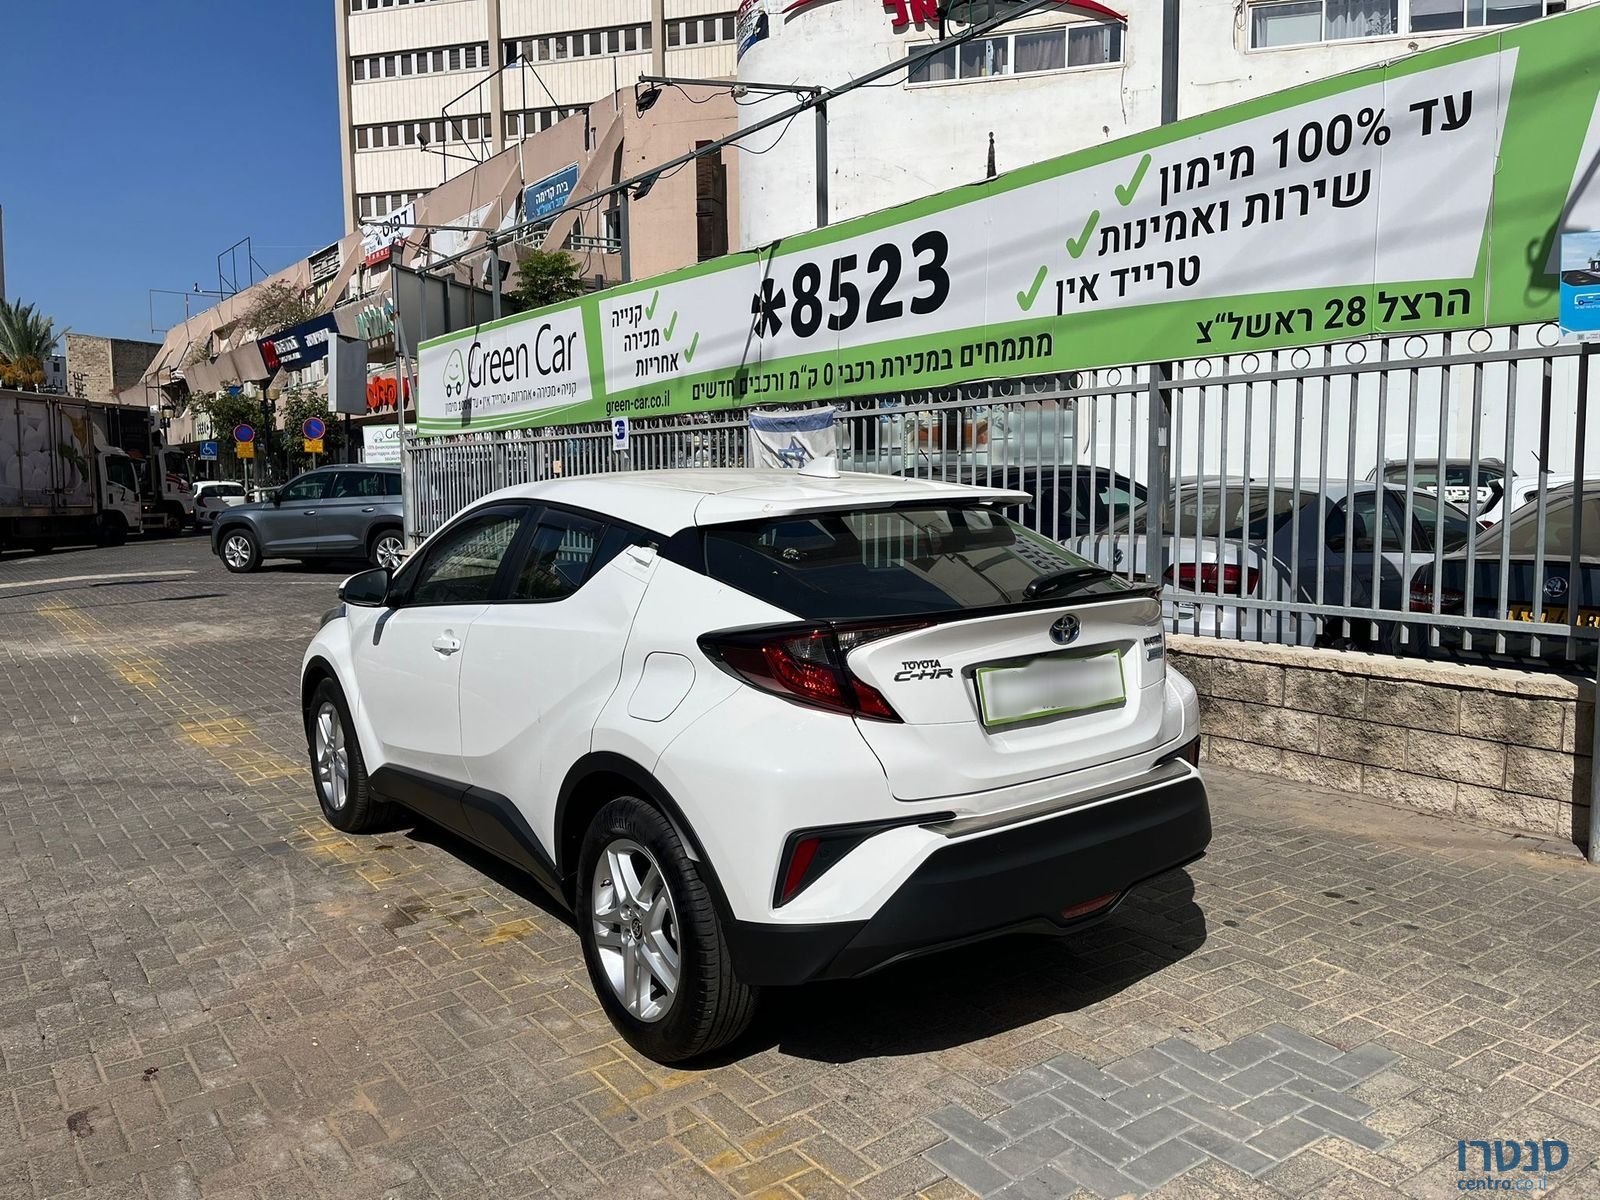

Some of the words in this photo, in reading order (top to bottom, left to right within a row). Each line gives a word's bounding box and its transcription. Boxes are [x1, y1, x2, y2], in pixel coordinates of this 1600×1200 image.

[1409, 90, 1473, 136] עד
[1272, 107, 1391, 169] 100%
[1159, 145, 1255, 207] מימון
[1242, 169, 1372, 228] שירות
[1098, 200, 1230, 257] ואמינות
[1111, 255, 1201, 298] טרייד
[1055, 273, 1100, 316] אין
[1378, 289, 1471, 323] הרצל
[612, 305, 643, 329] קנייה
[1324, 296, 1366, 329] 28
[468, 341, 529, 389] Green
[535, 323, 578, 376] Car
[624, 328, 660, 352] מכירה
[960, 332, 1053, 368] מתמחים
[635, 353, 679, 378] אחריות
[838, 360, 876, 385] רכבי
[880, 349, 953, 377] במכירת
[692, 379, 735, 401] חדשים
[740, 370, 785, 396] ורכבים
[605, 390, 671, 416] green-car.co.il
[894, 667, 954, 682] C-HR
[901, 659, 942, 671] TOYOTA
